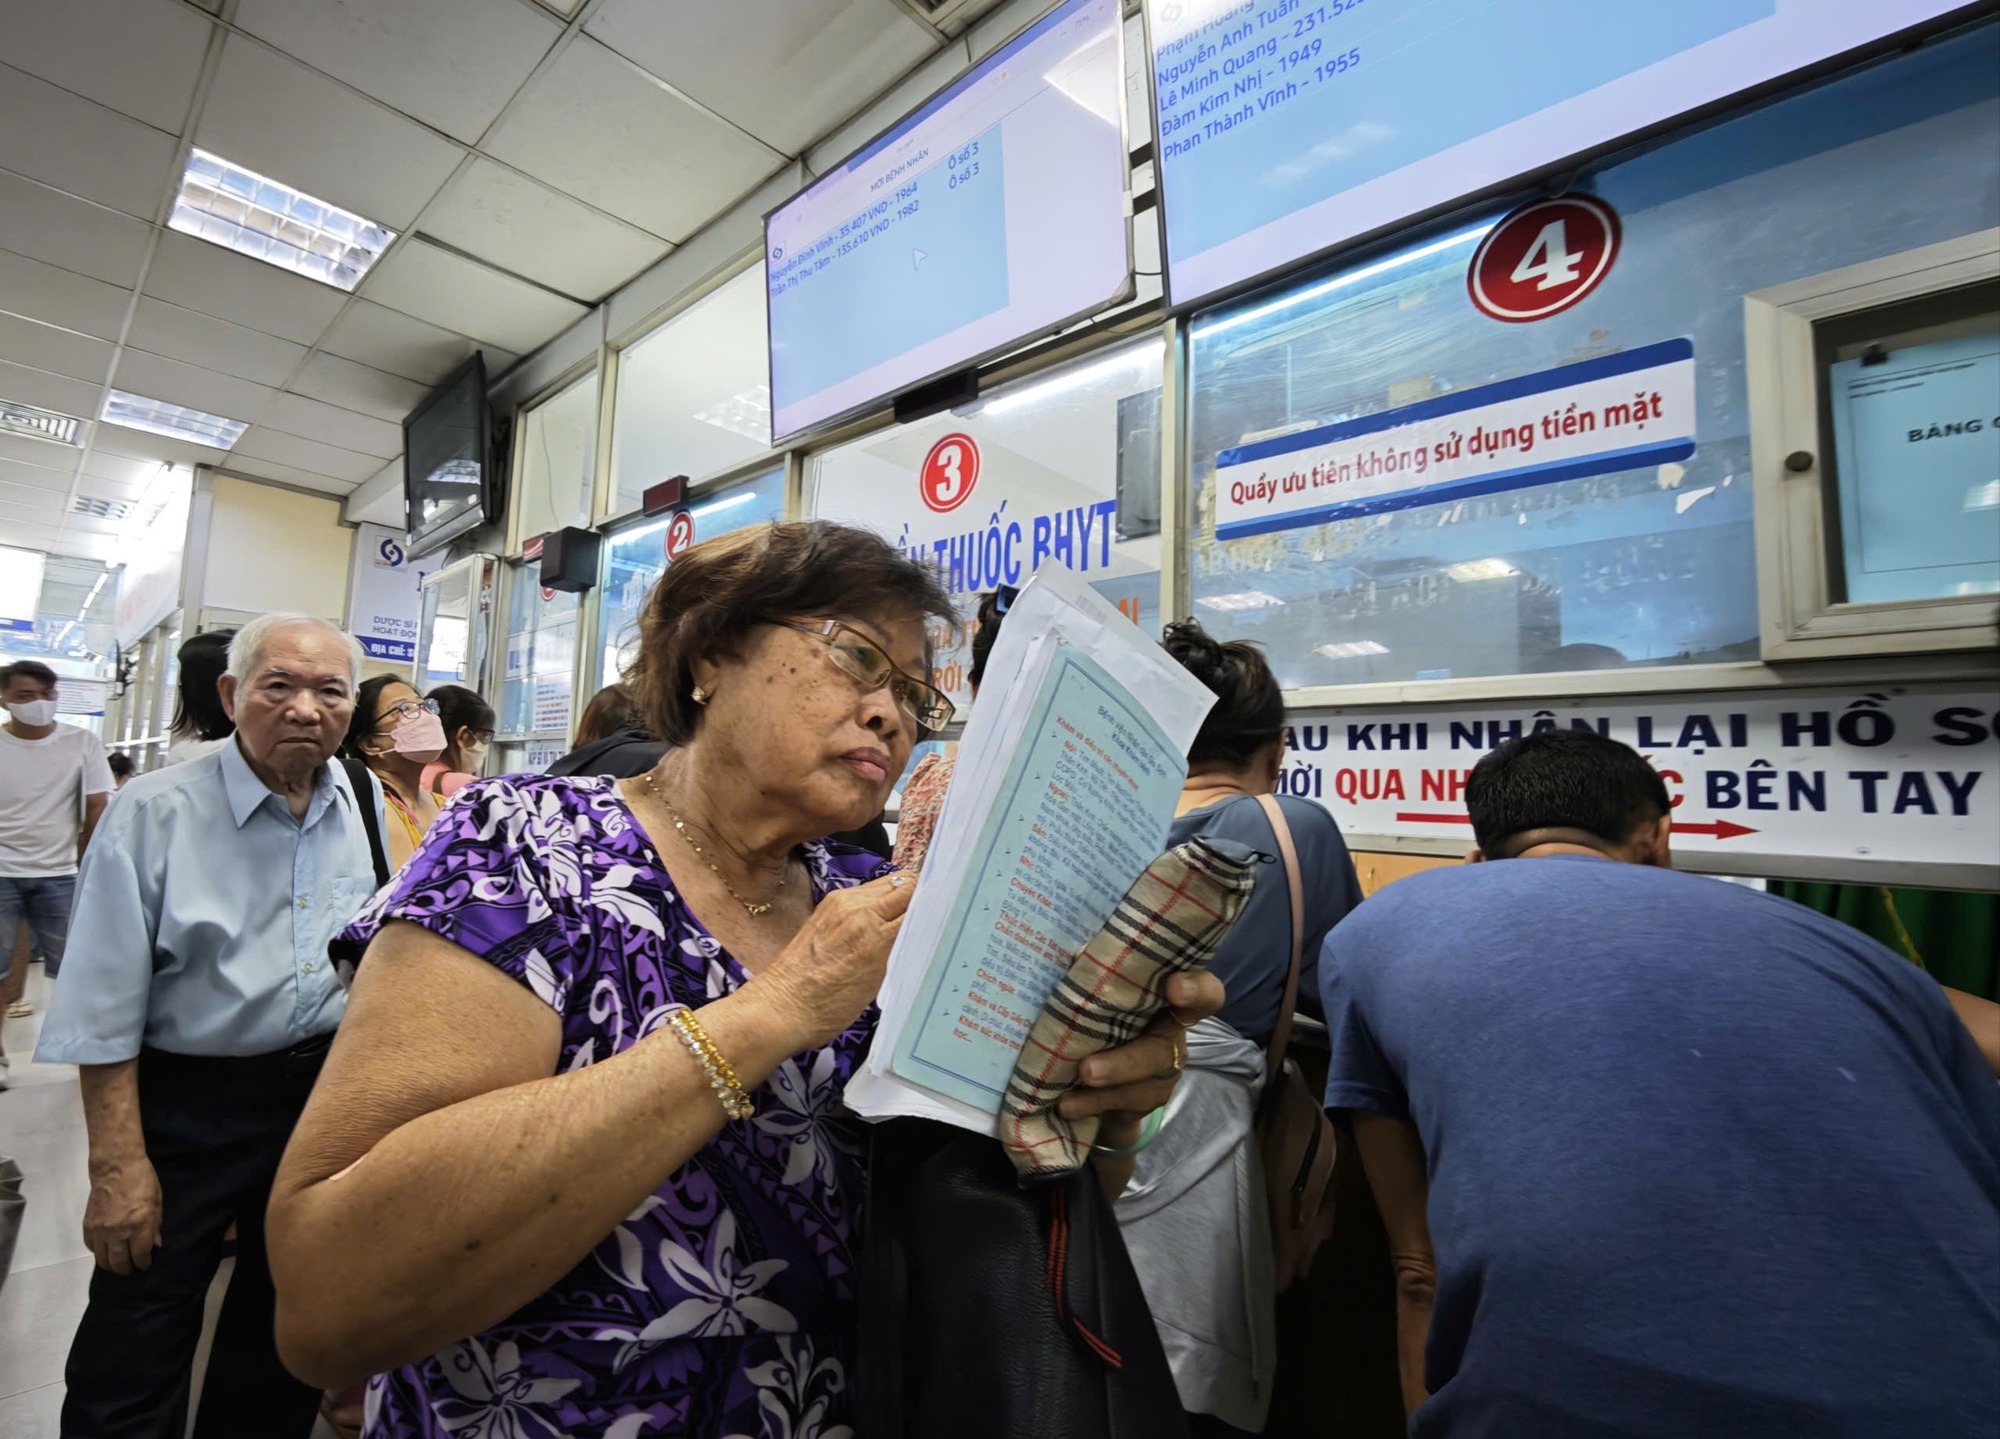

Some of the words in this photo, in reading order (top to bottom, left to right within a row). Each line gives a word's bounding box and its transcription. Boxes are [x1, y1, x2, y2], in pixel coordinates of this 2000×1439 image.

[1158, 42, 1217, 87] Nguyễn
[1221, 21, 1254, 52] Anh
[1160, 90, 1178, 112] Lê
[1180, 69, 1219, 100] Minh
[1223, 38, 1277, 75] Quang
[1162, 112, 1197, 137] Đàm
[1200, 91, 1230, 117] Kim
[1234, 70, 1262, 98] Nhị
[1278, 38, 1322, 73] 1949
[1164, 133, 1201, 162] Phan
[1203, 104, 1254, 140] Thành
[1258, 81, 1297, 112] Vĩnh
[1314, 48, 1361, 83] 1955
[948, 154, 957, 170] Ô
[958, 143, 971, 165] số
[971, 142, 979, 156] 3
[949, 173, 958, 190] Ô
[959, 165, 971, 184] số
[972, 162, 980, 176] 3
[799, 265, 813, 281] Thu
[837, 230, 869, 258] 135.610
[869, 218, 890, 237] VND
[897, 200, 919, 222] 1982
[839, 214, 867, 239] 35.407
[868, 201, 888, 220] VND
[896, 181, 918, 204] 1964
[1509, 218, 1585, 291] 4
[936, 444, 963, 503] 3
[1282, 472, 1307, 493] ưu
[1311, 461, 1351, 488] tiên
[1356, 446, 1428, 479] không
[1434, 431, 1463, 463] sử
[1467, 423, 1535, 460] dụng
[1604, 391, 1663, 430] mặt
[672, 521, 689, 554] 2
[933, 499, 1022, 595] THUỐC
[1033, 499, 1118, 572] BHYT
[1284, 724, 1329, 752] AU
[1347, 722, 1429, 751] KHI
[1637, 713, 1748, 755] LẠI
[1780, 692, 1896, 748] HỒ
[1335, 768, 1406, 805] QUA
[1706, 758, 1827, 812] BÊN
[1848, 770, 1983, 816] TAY
